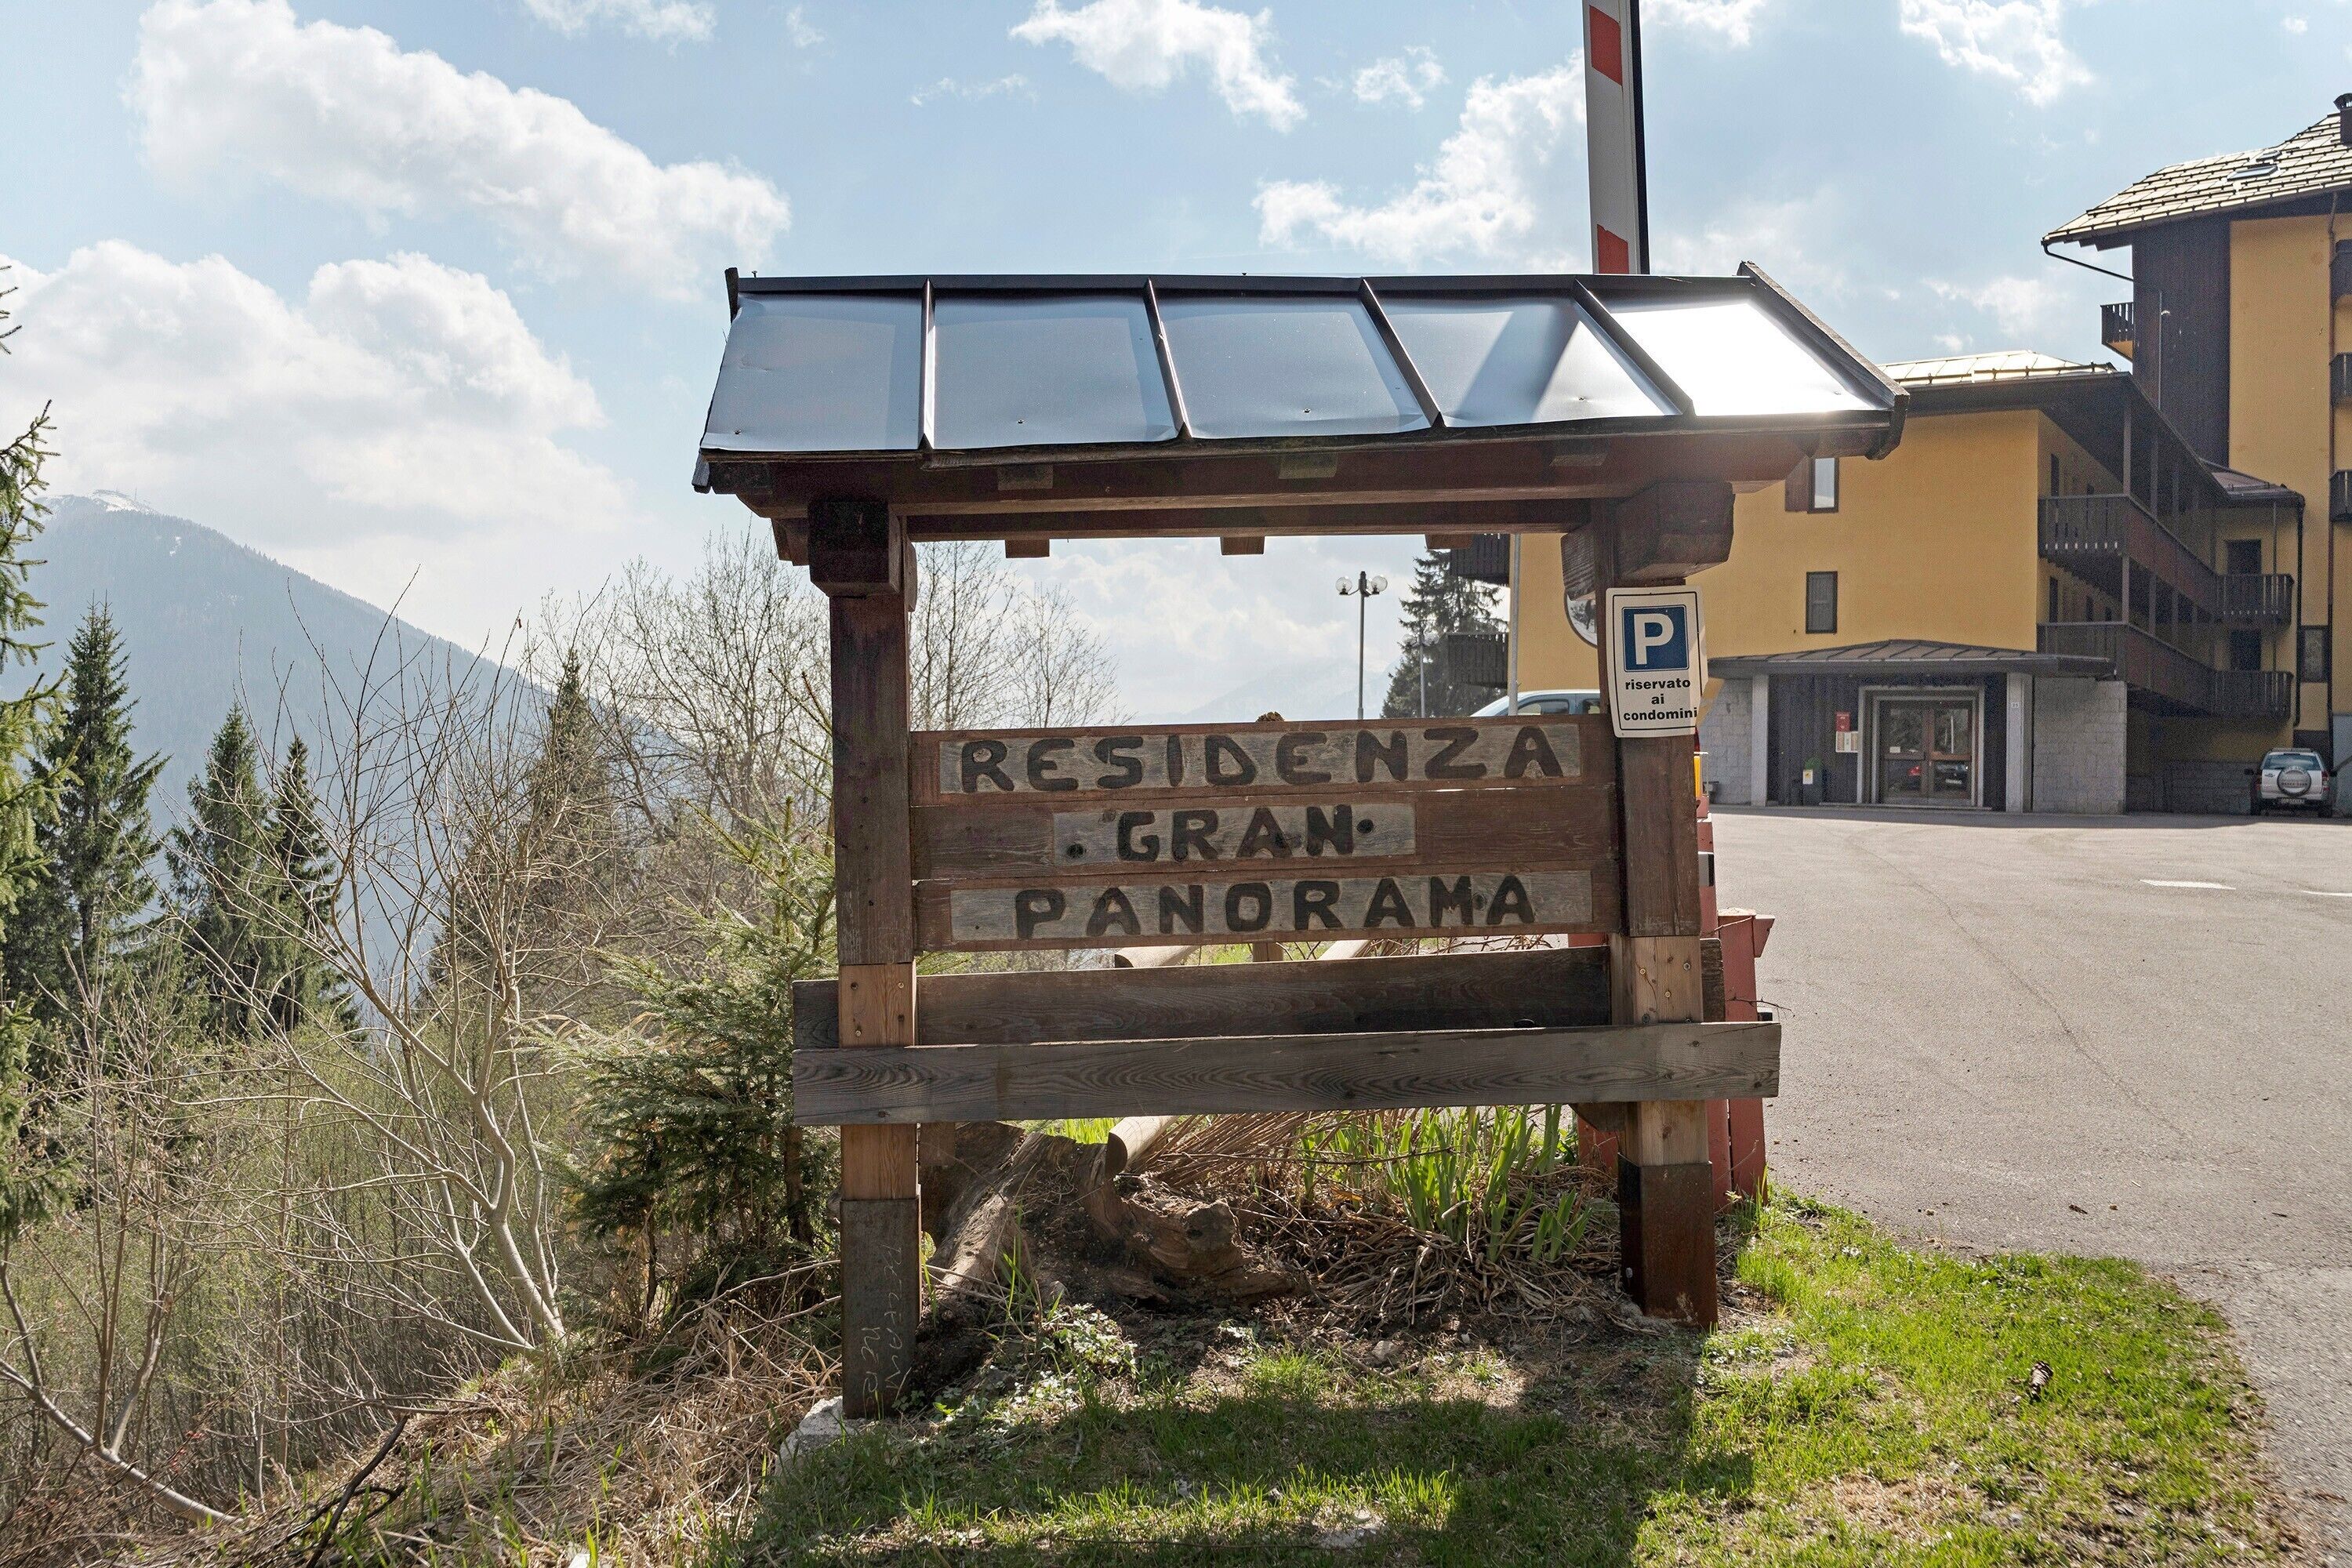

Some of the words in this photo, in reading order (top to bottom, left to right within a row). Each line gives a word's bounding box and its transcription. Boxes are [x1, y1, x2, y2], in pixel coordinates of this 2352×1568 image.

[1635, 614, 1674, 665] P
[1625, 678, 1691, 690] riservato
[1650, 694, 1664, 705] ai
[1624, 707, 1697, 720] condomini
[961, 726, 1564, 793] RESIDENZA
[1118, 805, 1354, 862] GRAN
[1016, 876, 1534, 939] PANORAMA
